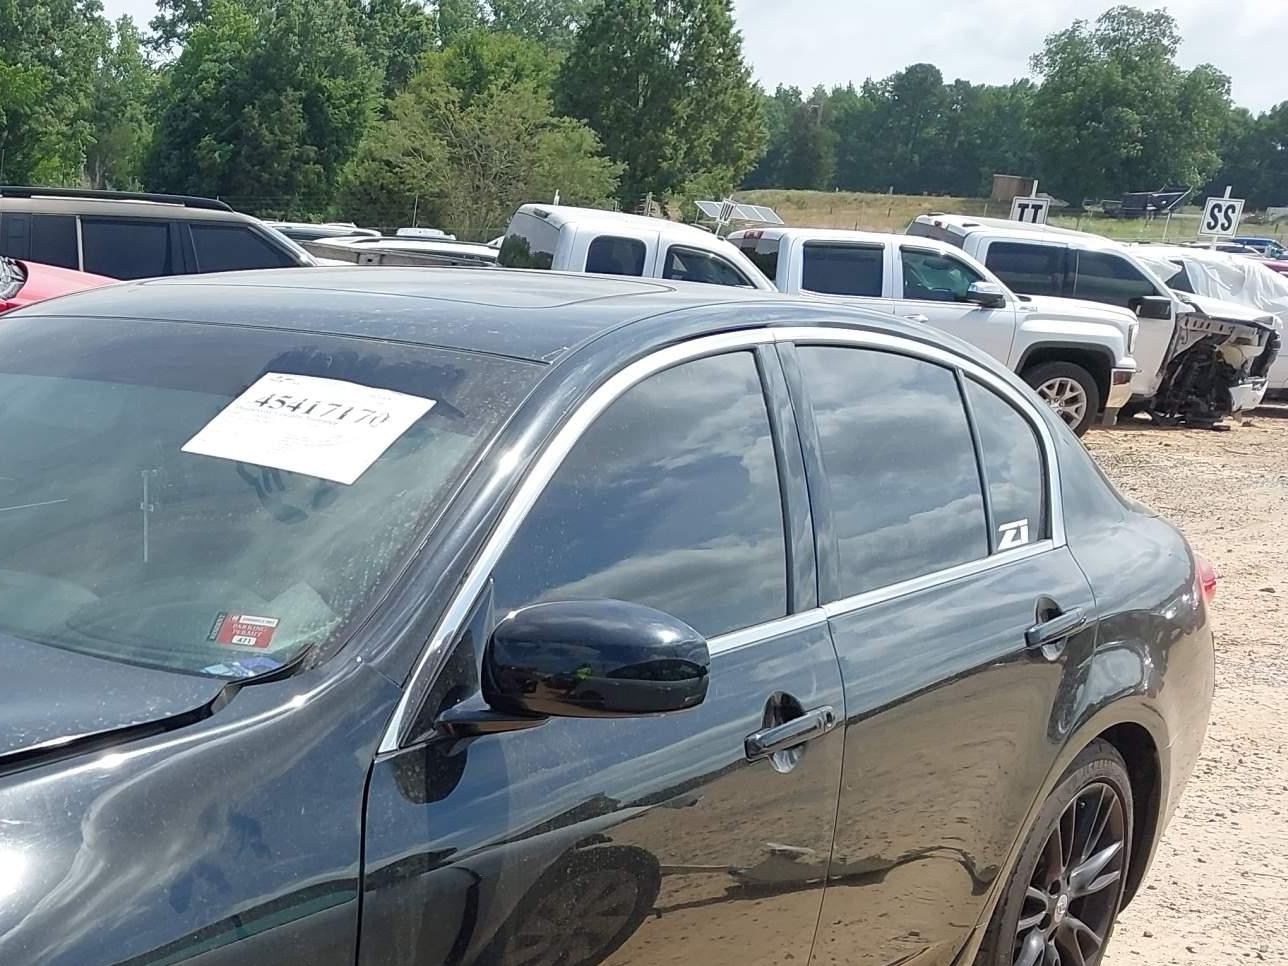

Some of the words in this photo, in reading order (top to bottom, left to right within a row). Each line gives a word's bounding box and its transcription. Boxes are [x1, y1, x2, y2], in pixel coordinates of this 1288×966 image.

[1017, 203, 1044, 223] TT
[1206, 202, 1236, 232] SS
[254, 393, 391, 427] 45417170
